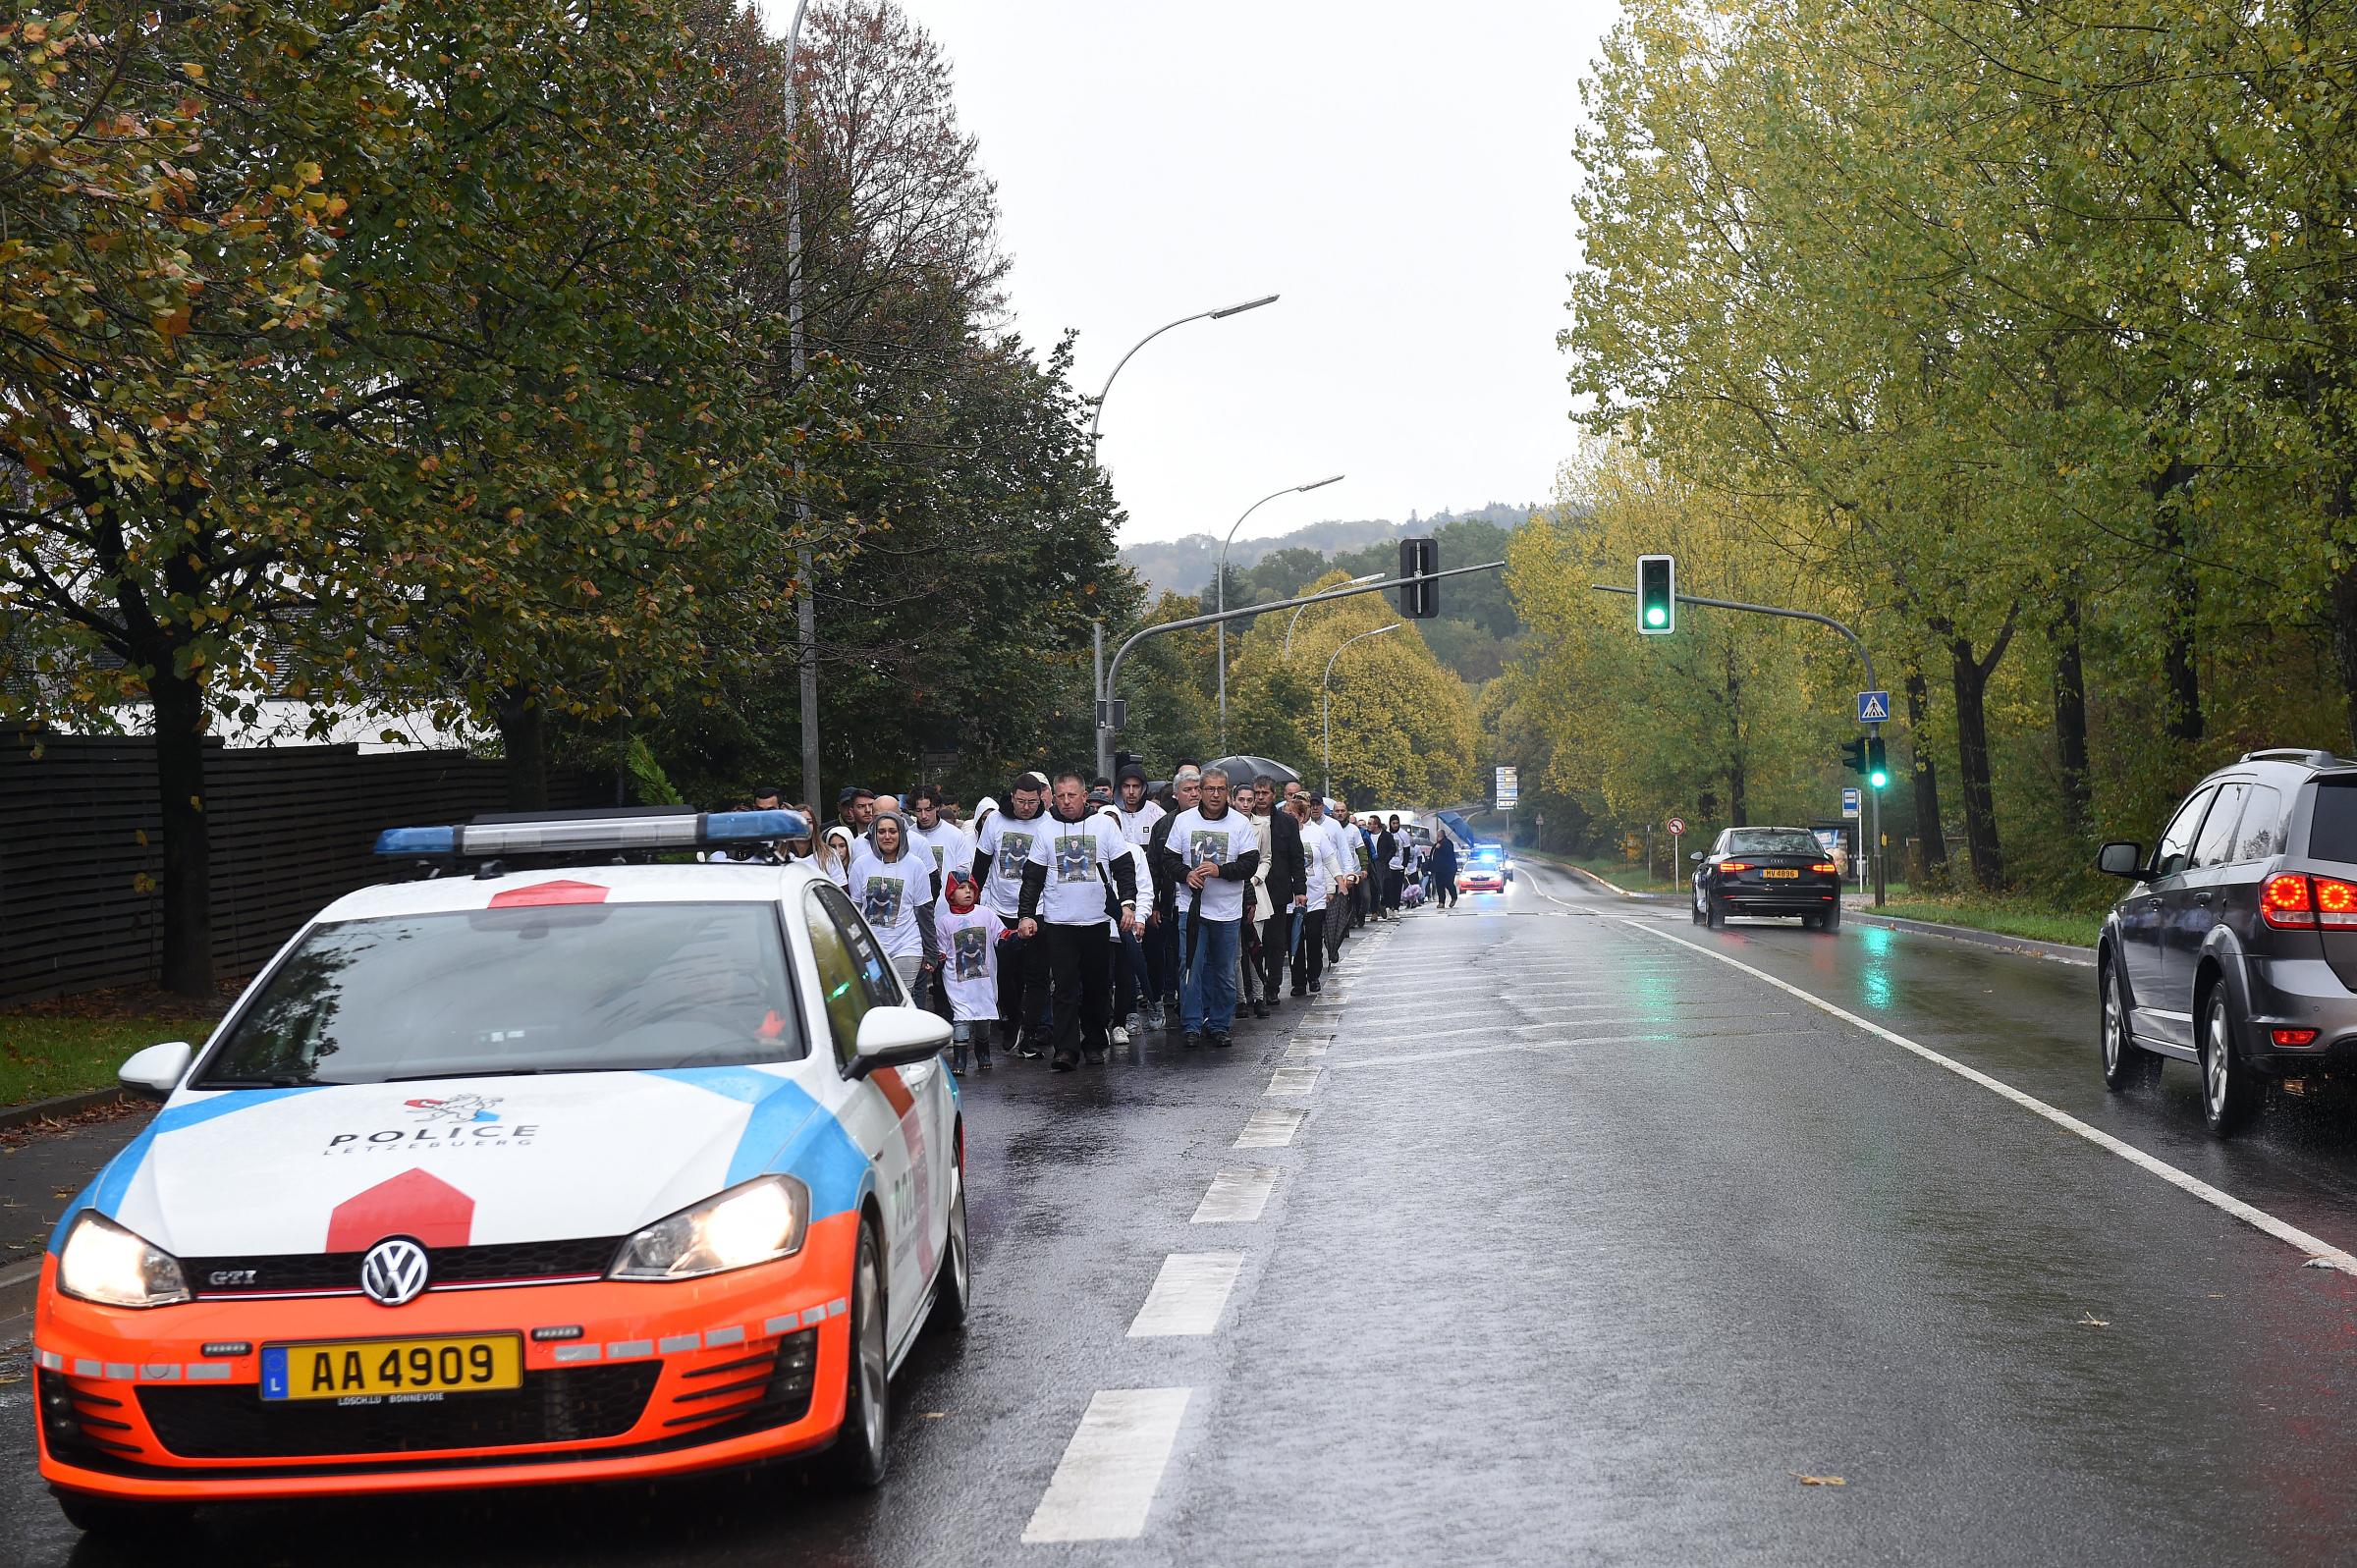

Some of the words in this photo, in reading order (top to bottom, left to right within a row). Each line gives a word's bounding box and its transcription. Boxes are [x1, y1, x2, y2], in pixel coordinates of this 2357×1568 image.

[329, 1125, 539, 1147] POLICE
[209, 1270, 257, 1285] GTI
[269, 1378, 281, 1391] L
[311, 1351, 364, 1391] AA
[378, 1344, 494, 1387] 4909
